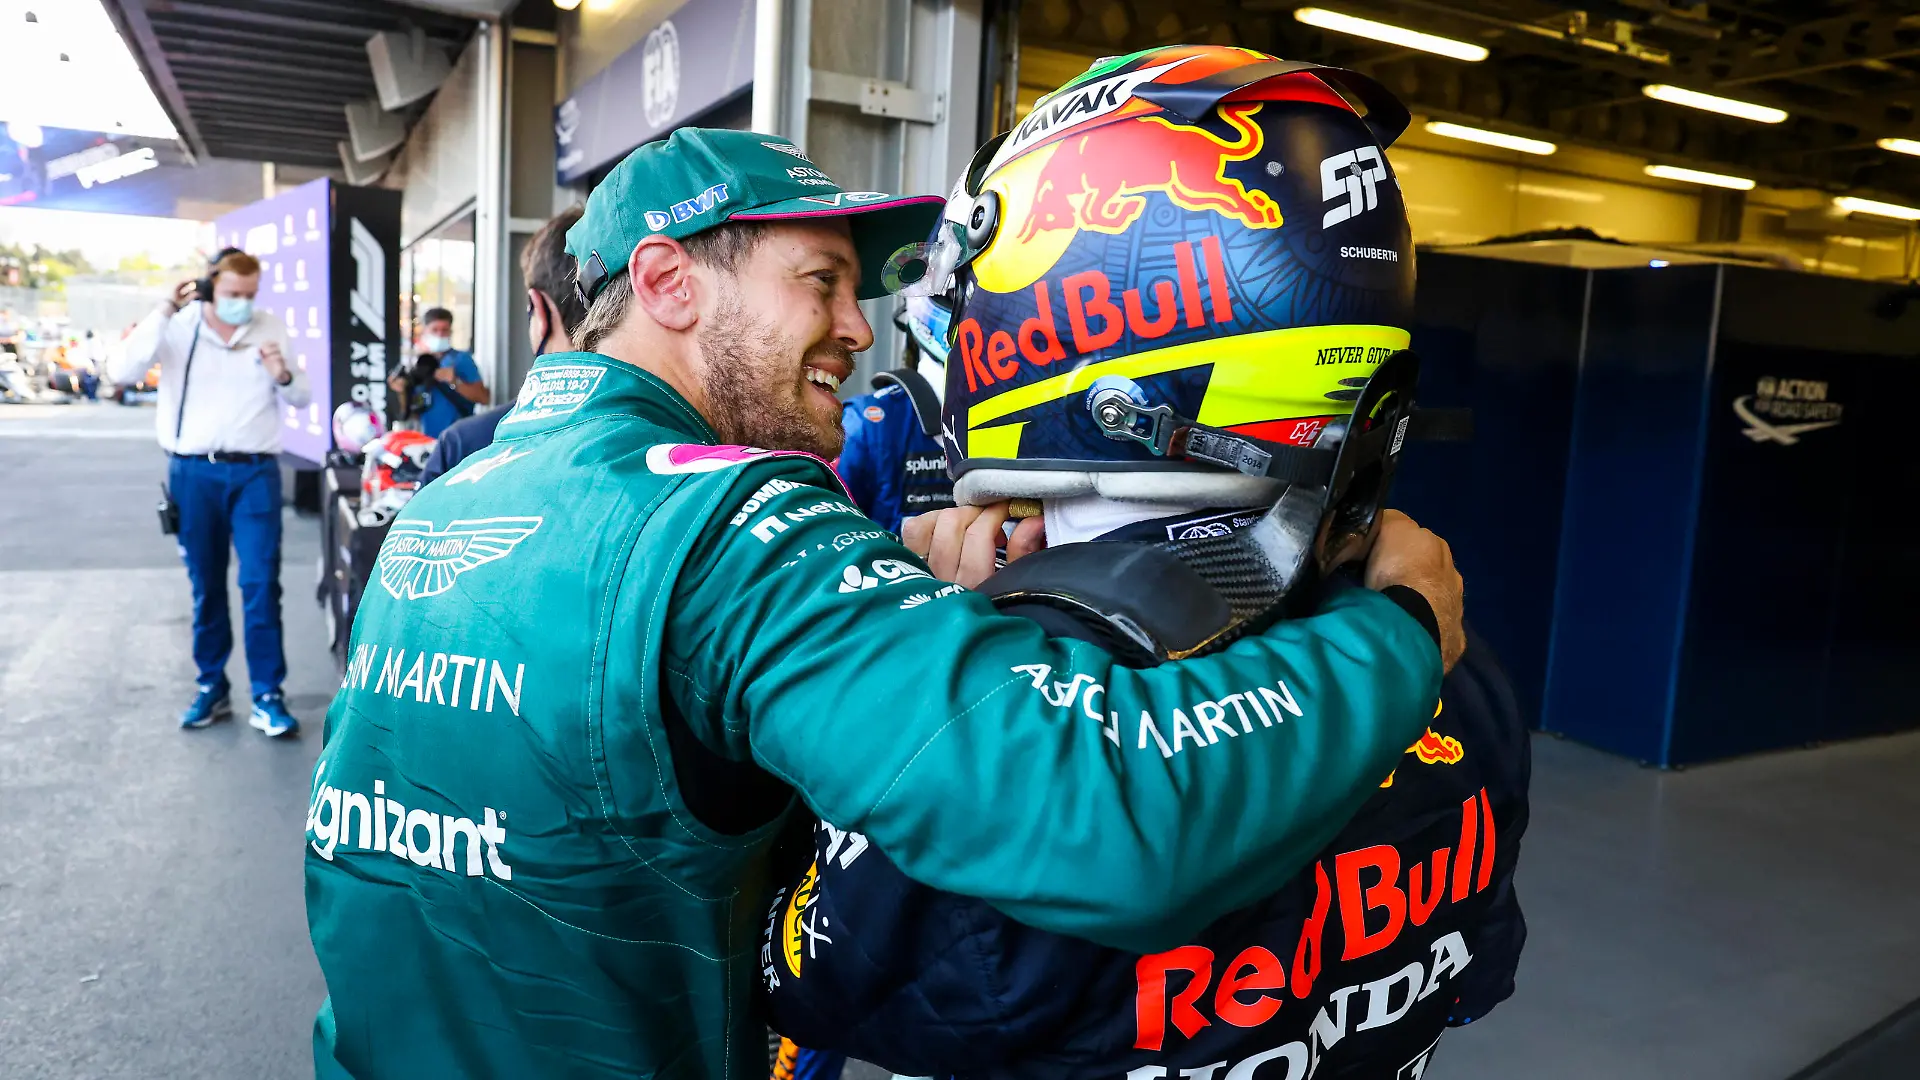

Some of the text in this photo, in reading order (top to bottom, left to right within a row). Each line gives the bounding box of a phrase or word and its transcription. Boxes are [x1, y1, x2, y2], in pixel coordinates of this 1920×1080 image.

[1012, 78, 1128, 147] KAVAK
[670, 183, 729, 224] BWT
[1340, 246, 1398, 262] SCHUBERTH
[958, 235, 1233, 393] Red Bull
[1315, 346, 1364, 366] NEVER
[1777, 379, 1828, 401] ACTION
[1242, 454, 1262, 470] 2014
[784, 501, 869, 523] NetA
[393, 537, 468, 557] ASTON MARTIN
[832, 531, 899, 552] LOND
[374, 646, 526, 717] MARTIN
[305, 760, 512, 882] gnizant
[1133, 785, 1496, 1051] Red Bull
[1126, 930, 1474, 1080] ONDA
